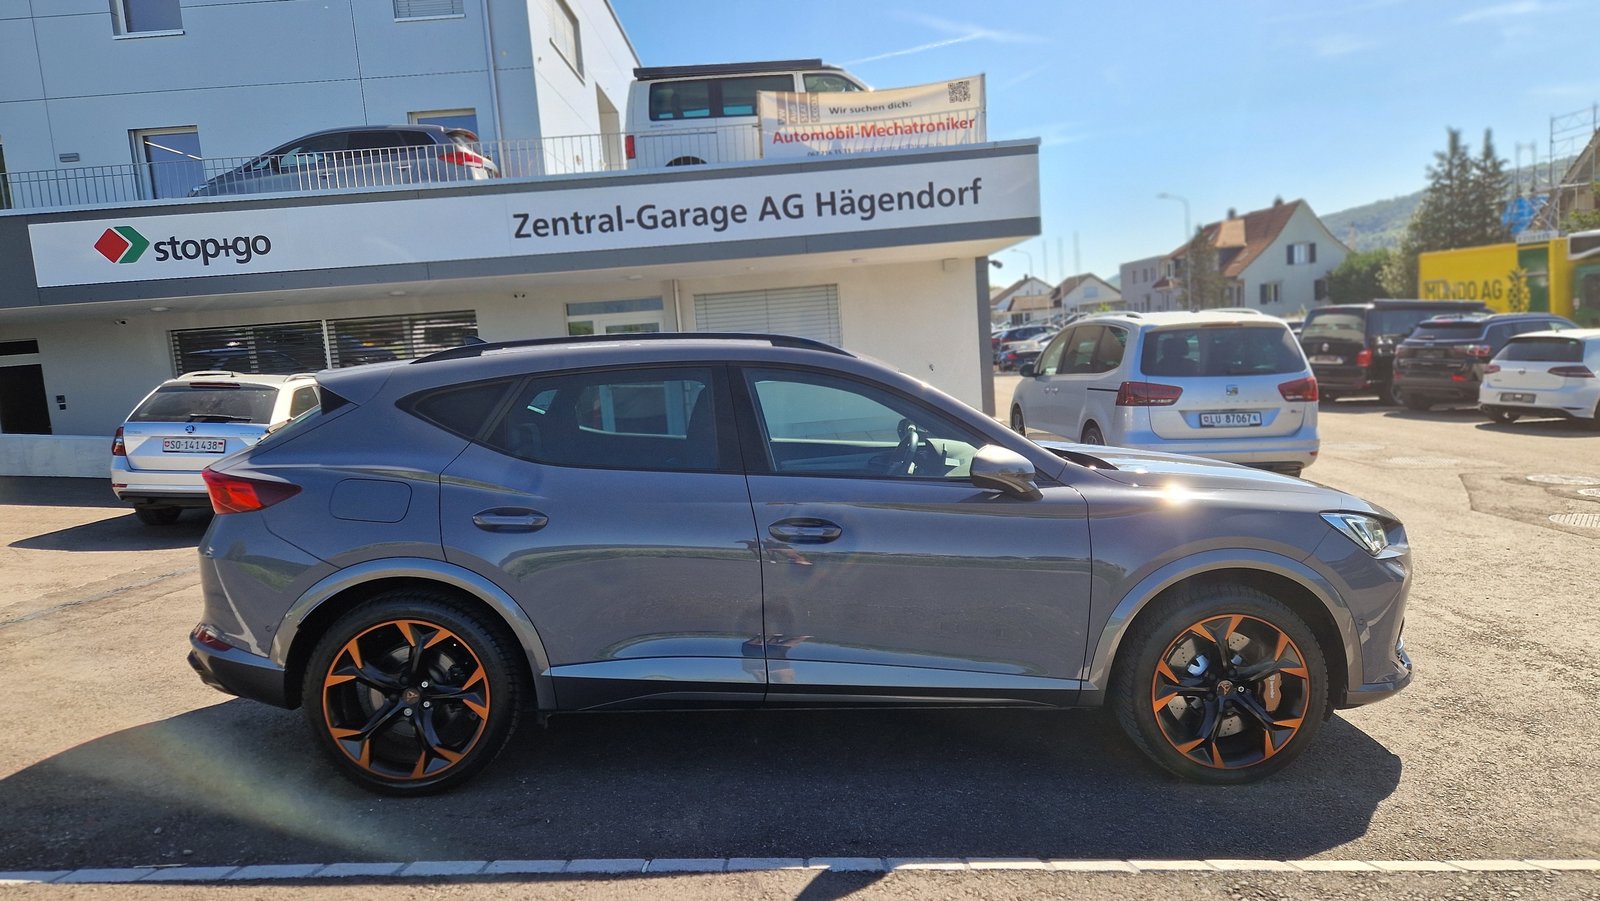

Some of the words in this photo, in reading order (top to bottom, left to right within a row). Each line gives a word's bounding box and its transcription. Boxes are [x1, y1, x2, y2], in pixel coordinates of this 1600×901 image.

[828, 106, 847, 115] Wir
[849, 104, 885, 114] suchen
[887, 101, 912, 110] dich:
[772, 116, 976, 146] Automobil-Mechatroniker
[513, 201, 747, 239] Zentral-Garage
[758, 193, 804, 222] AG
[816, 177, 982, 221] Hägendorf
[154, 235, 272, 266] stop+go
[1481, 279, 1503, 300] AG
[1225, 414, 1252, 424] 87067
